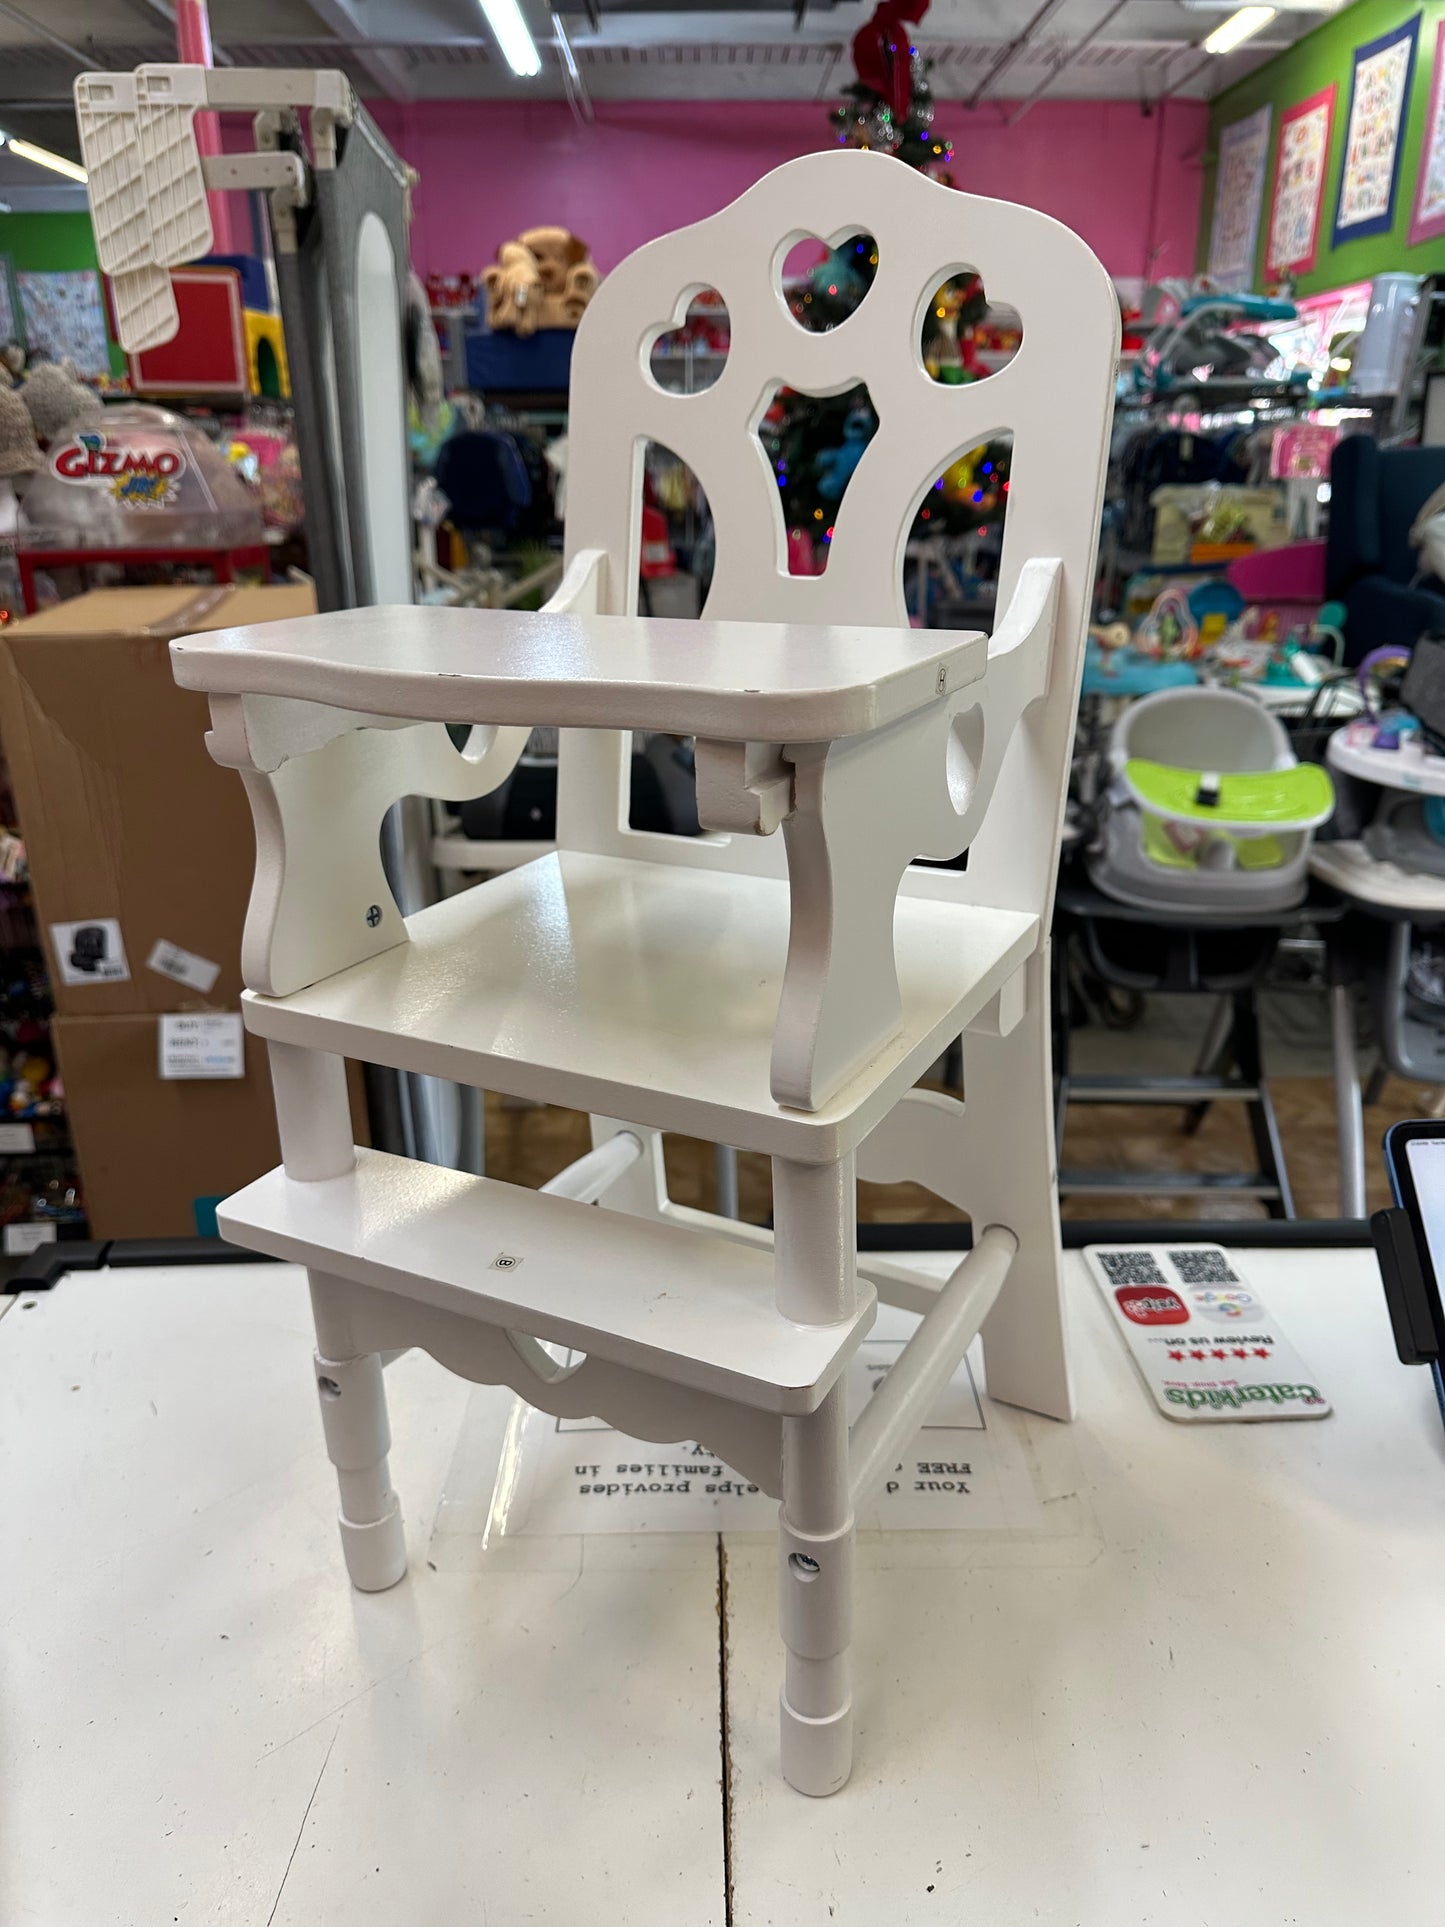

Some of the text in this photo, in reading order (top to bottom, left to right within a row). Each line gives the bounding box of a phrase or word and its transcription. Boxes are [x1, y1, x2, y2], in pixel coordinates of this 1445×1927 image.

[55, 447, 180, 477] GIZMO
[1189, 1336, 1211, 1345] us
[1213, 1333, 1275, 1346] Review
[574, 1463, 601, 1478] in
[616, 1462, 724, 1478] families
[917, 1461, 972, 1474] FREE
[579, 1480, 691, 1497] provides
[704, 1480, 760, 1497] elps
[913, 1480, 971, 1494] Your
